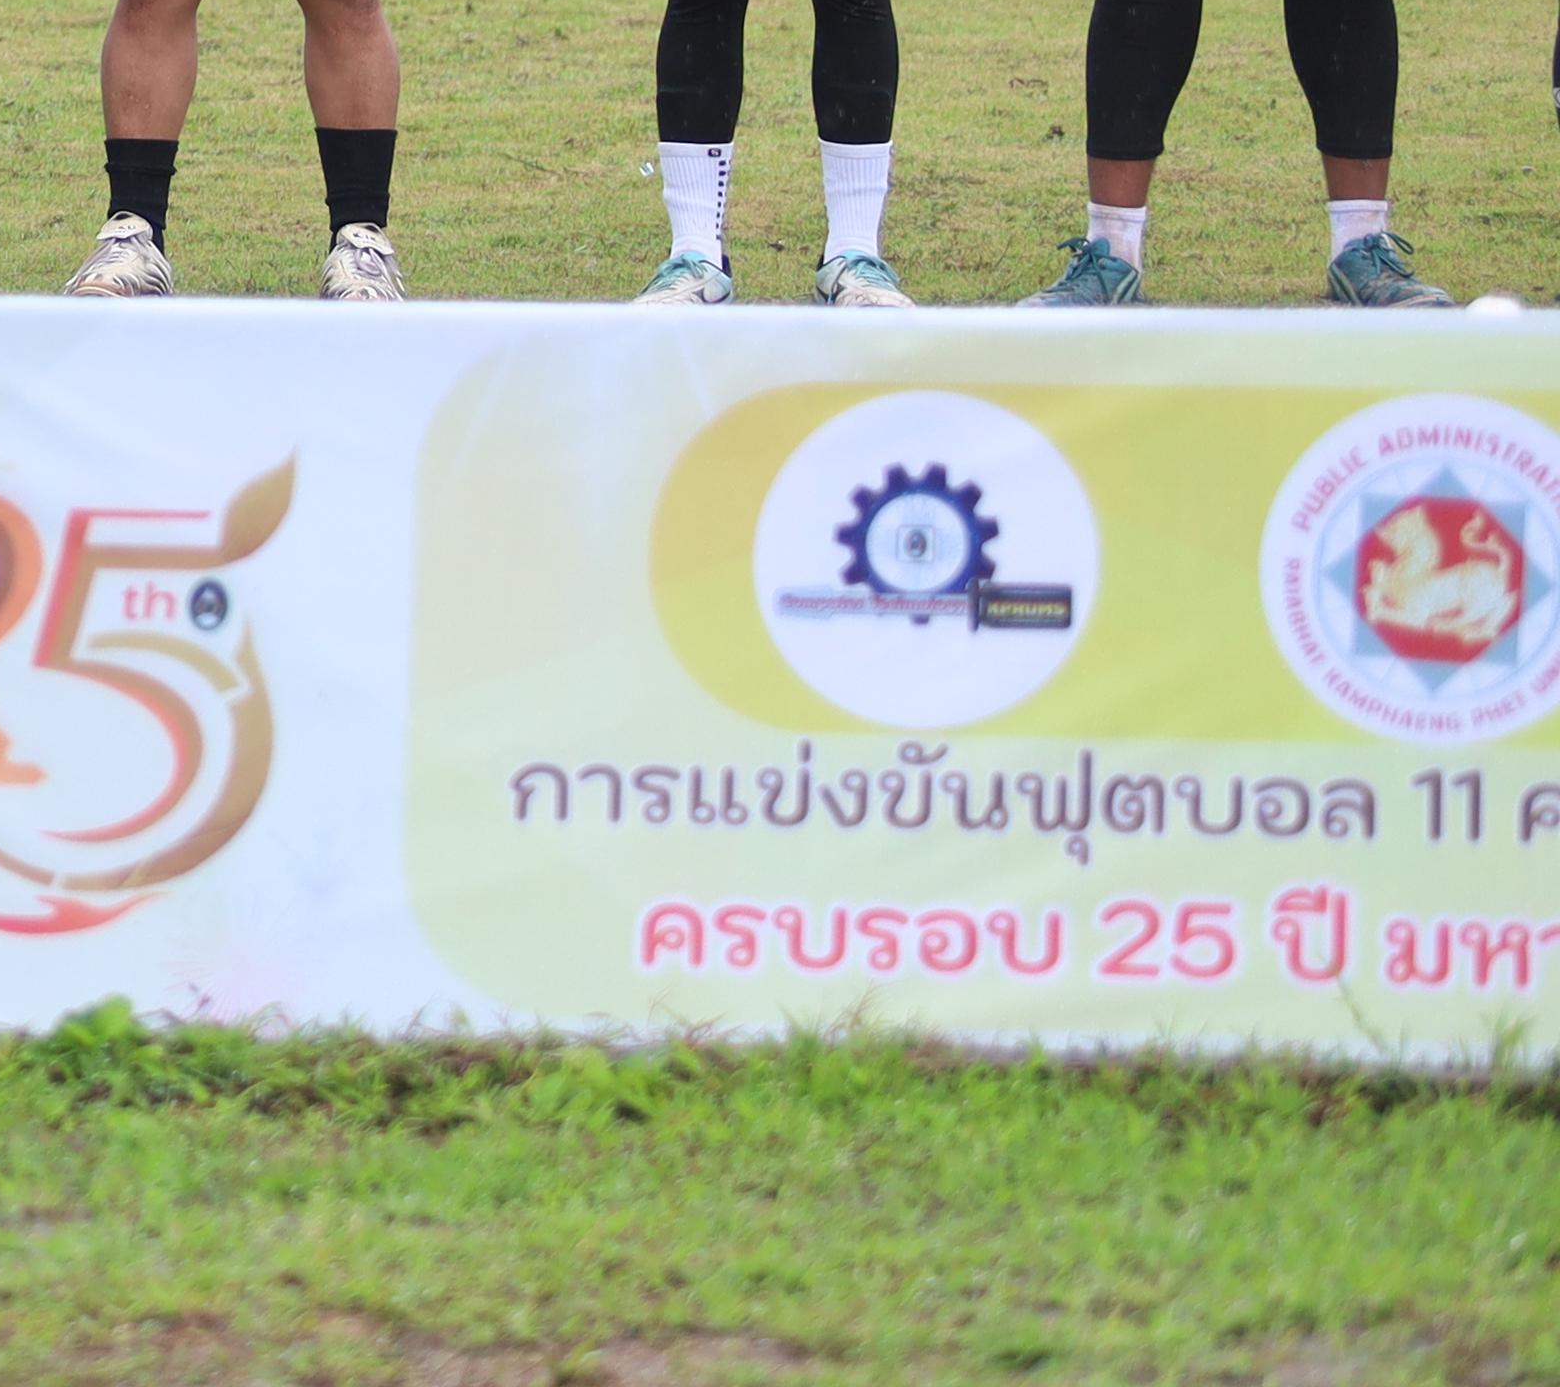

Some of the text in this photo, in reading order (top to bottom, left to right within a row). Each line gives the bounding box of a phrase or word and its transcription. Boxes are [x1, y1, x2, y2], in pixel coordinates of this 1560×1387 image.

[1291, 446, 1368, 532] PUBLIC
[121, 580, 177, 623] th
[510, 739, 1377, 865] การแข่งขันฟุตบอล
[1411, 768, 1481, 841] 11
[641, 902, 1064, 974] ครบรอบ
[1099, 899, 1235, 979] 25
[1271, 885, 1348, 982] ปี
